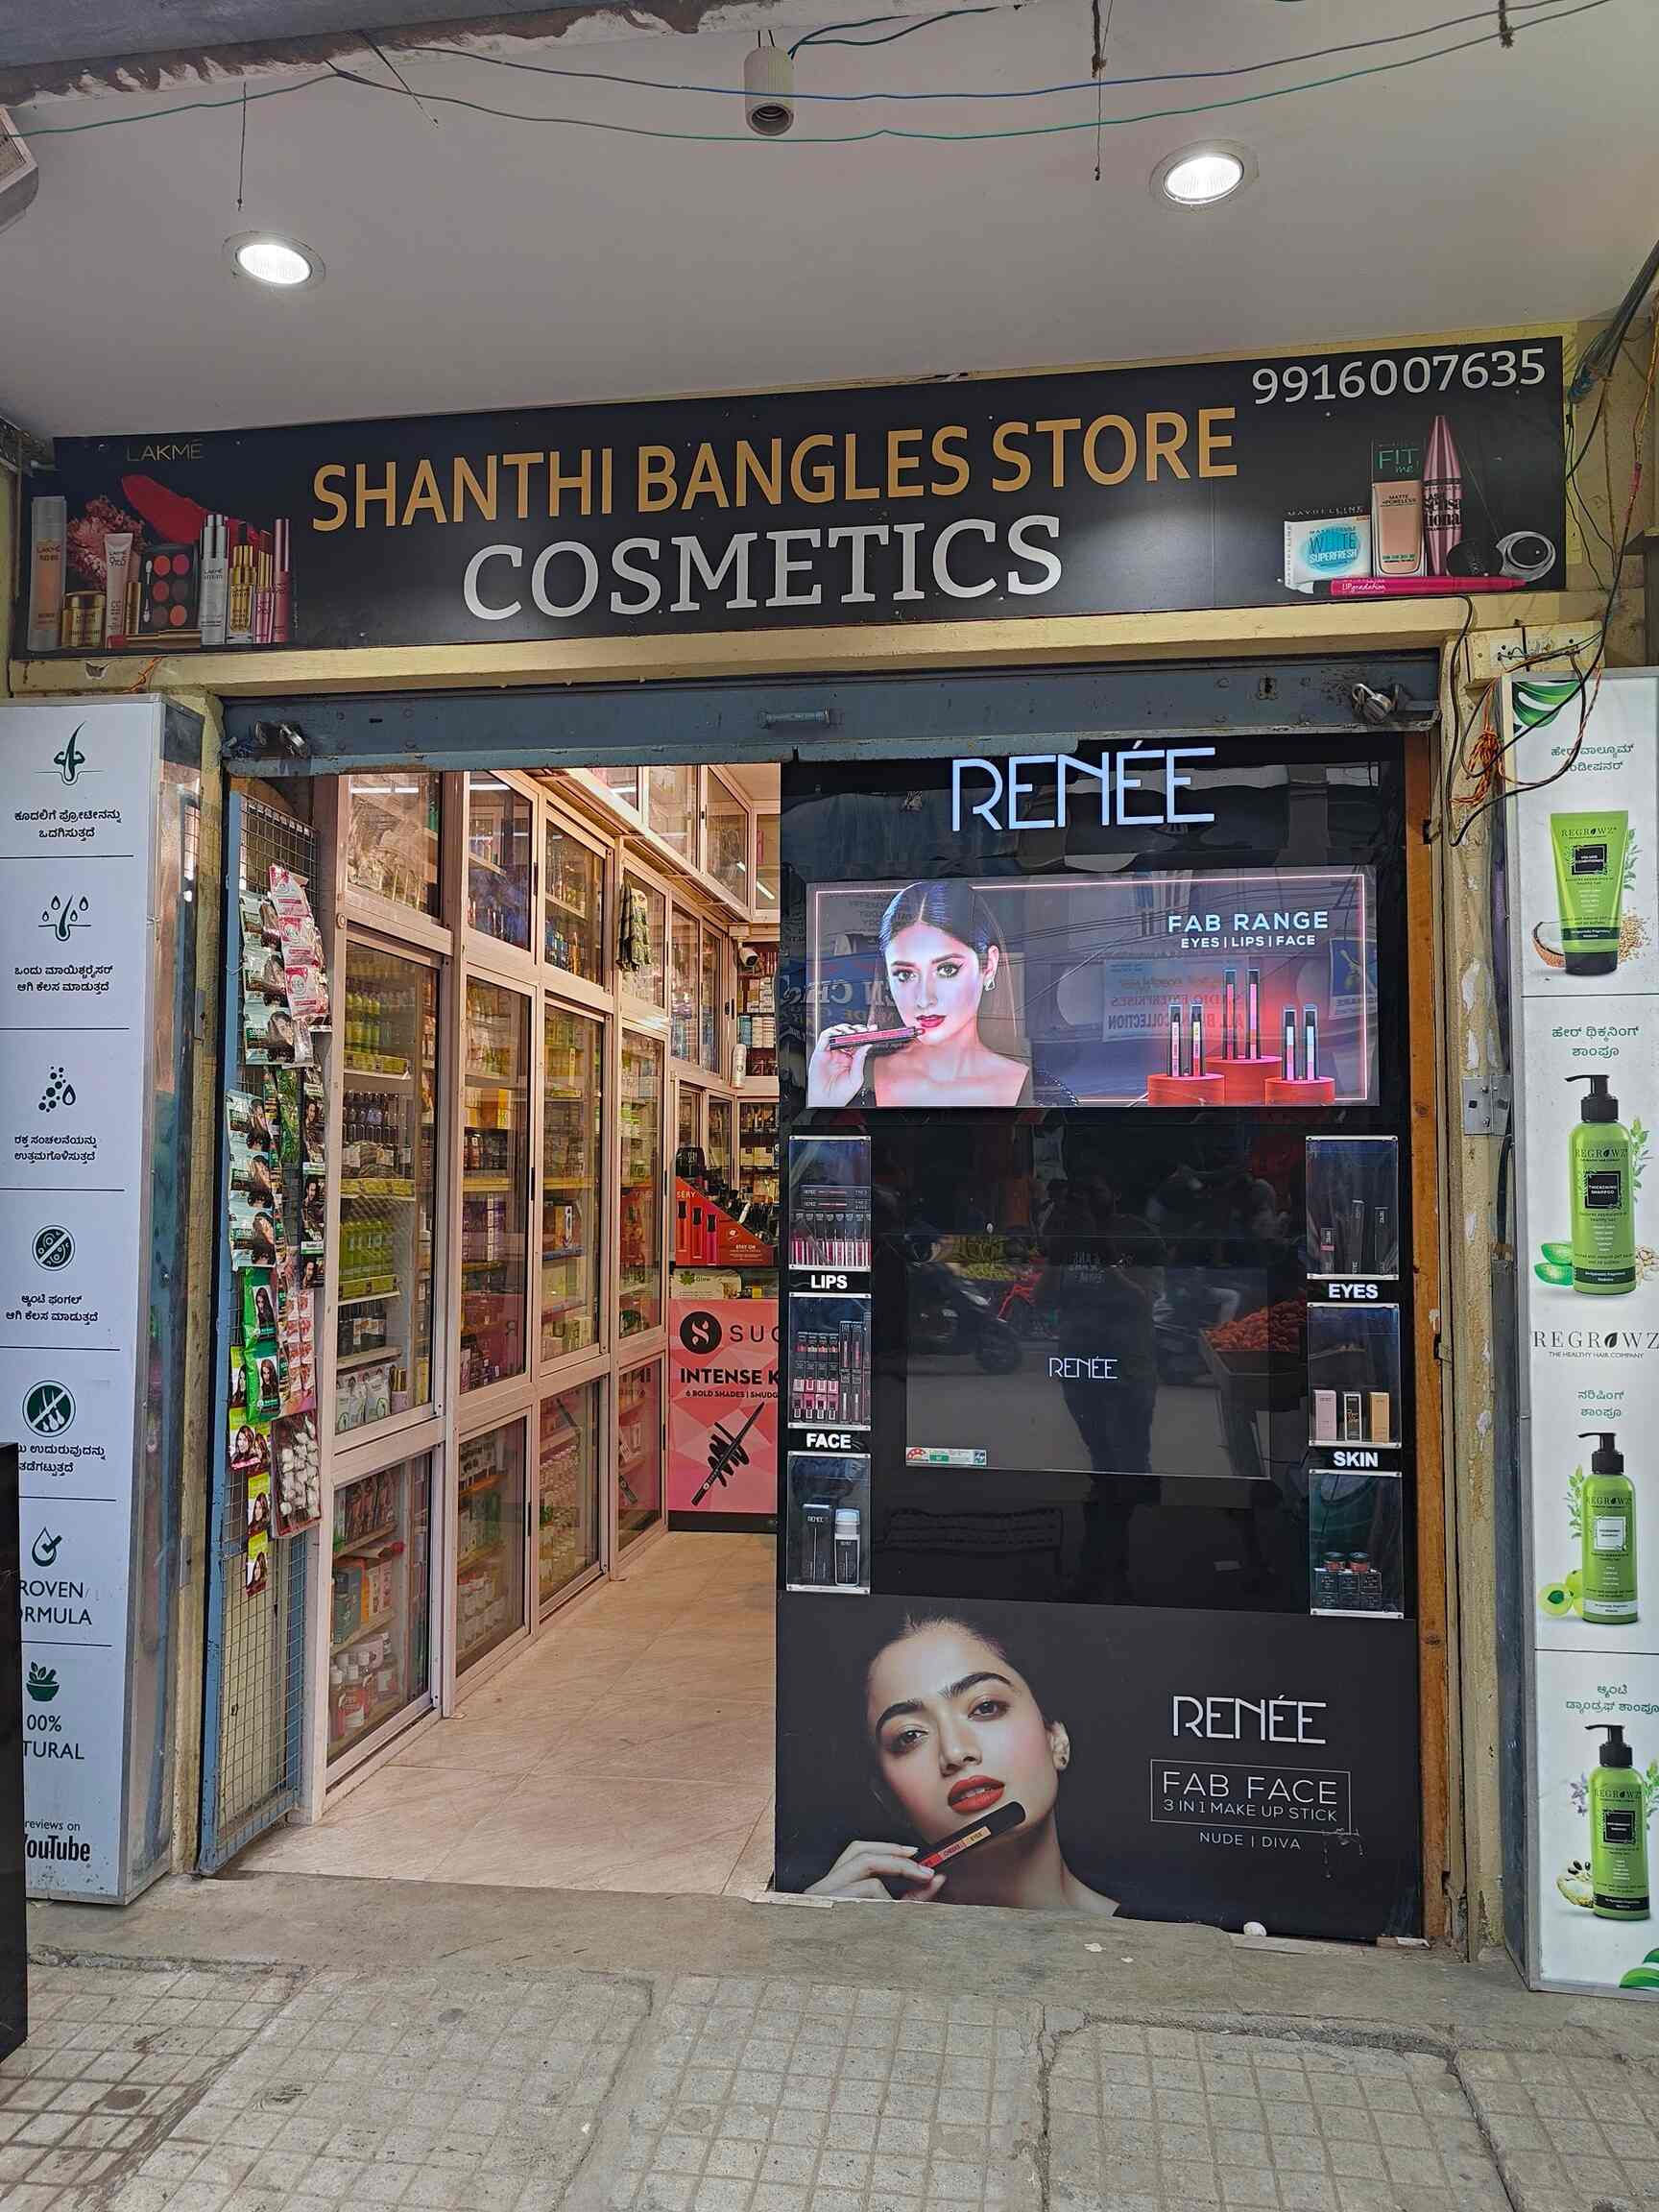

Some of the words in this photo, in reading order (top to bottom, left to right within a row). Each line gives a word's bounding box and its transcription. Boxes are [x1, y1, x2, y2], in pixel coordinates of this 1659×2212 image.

[1251, 348, 1546, 404] 9916007635
[1379, 448, 1420, 469] FIT
[313, 447, 613, 533] SHANTHI
[637, 424, 970, 515] BANGLES
[992, 406, 1238, 493] STORE
[464, 515, 1063, 621] COSMETICS
[952, 740, 1215, 831] RENÉE
[14, 809, 57, 821] ಕೂದಲಿಗೆ
[38, 827, 95, 841] ಒದಗಿಸುತ್ತದೆ
[1168, 913, 1221, 933] FAB
[1234, 911, 1329, 931] RANGE
[1181, 937, 1219, 949] EYES
[1232, 935, 1264, 948] LIPS
[1276, 934, 1316, 946] FACE
[14, 964, 42, 975] ಒಂದು
[16, 981, 34, 991] ಆಗಿ
[36, 981, 60, 991] ಕೆಲಸ
[62, 981, 109, 996] ಮಾಡುತ್ತದೆ
[1551, 1025, 1582, 1037] ಹೇರ್
[1572, 1046, 1620, 1059] ಶಾಂಪೂ
[14, 1135, 29, 1147] ರಕ್ತ
[811, 1275, 848, 1289] LIPS
[1329, 1284, 1378, 1299] EYES
[6, 1310, 22, 1320] ಆಗಿ
[25, 1310, 49, 1320] ಕೆಲಸ
[51, 1311, 99, 1326] ಮಾಡುತ್ತದೆ
[680, 1368, 762, 1384] INTENSE
[1049, 1356, 1118, 1379] RENÉE
[806, 1433, 852, 1449] FACE
[1334, 1451, 1378, 1467] SKIN
[19, 1580, 84, 1599] ROVEN
[18, 1606, 92, 1625] RMULA
[27, 1714, 61, 1732] 00%
[1173, 1695, 1327, 1744] RENÉE
[23, 1741, 84, 1760] TURAL
[1163, 1771, 1229, 1797] FAB
[1247, 1776, 1337, 1805] FACE
[1164, 1798, 1174, 1812] 3
[1179, 1800, 1194, 1813] IN
[1199, 1801, 1206, 1814] 1
[1210, 1801, 1257, 1816] MAKE
[1261, 1805, 1284, 1818] UP
[1288, 1806, 1337, 1822] STICK
[25, 1819, 65, 1831] reviews
[67, 1822, 81, 1832] on
[1200, 1831, 1244, 1846] NUDE
[1262, 1835, 1301, 1850] DIVA
